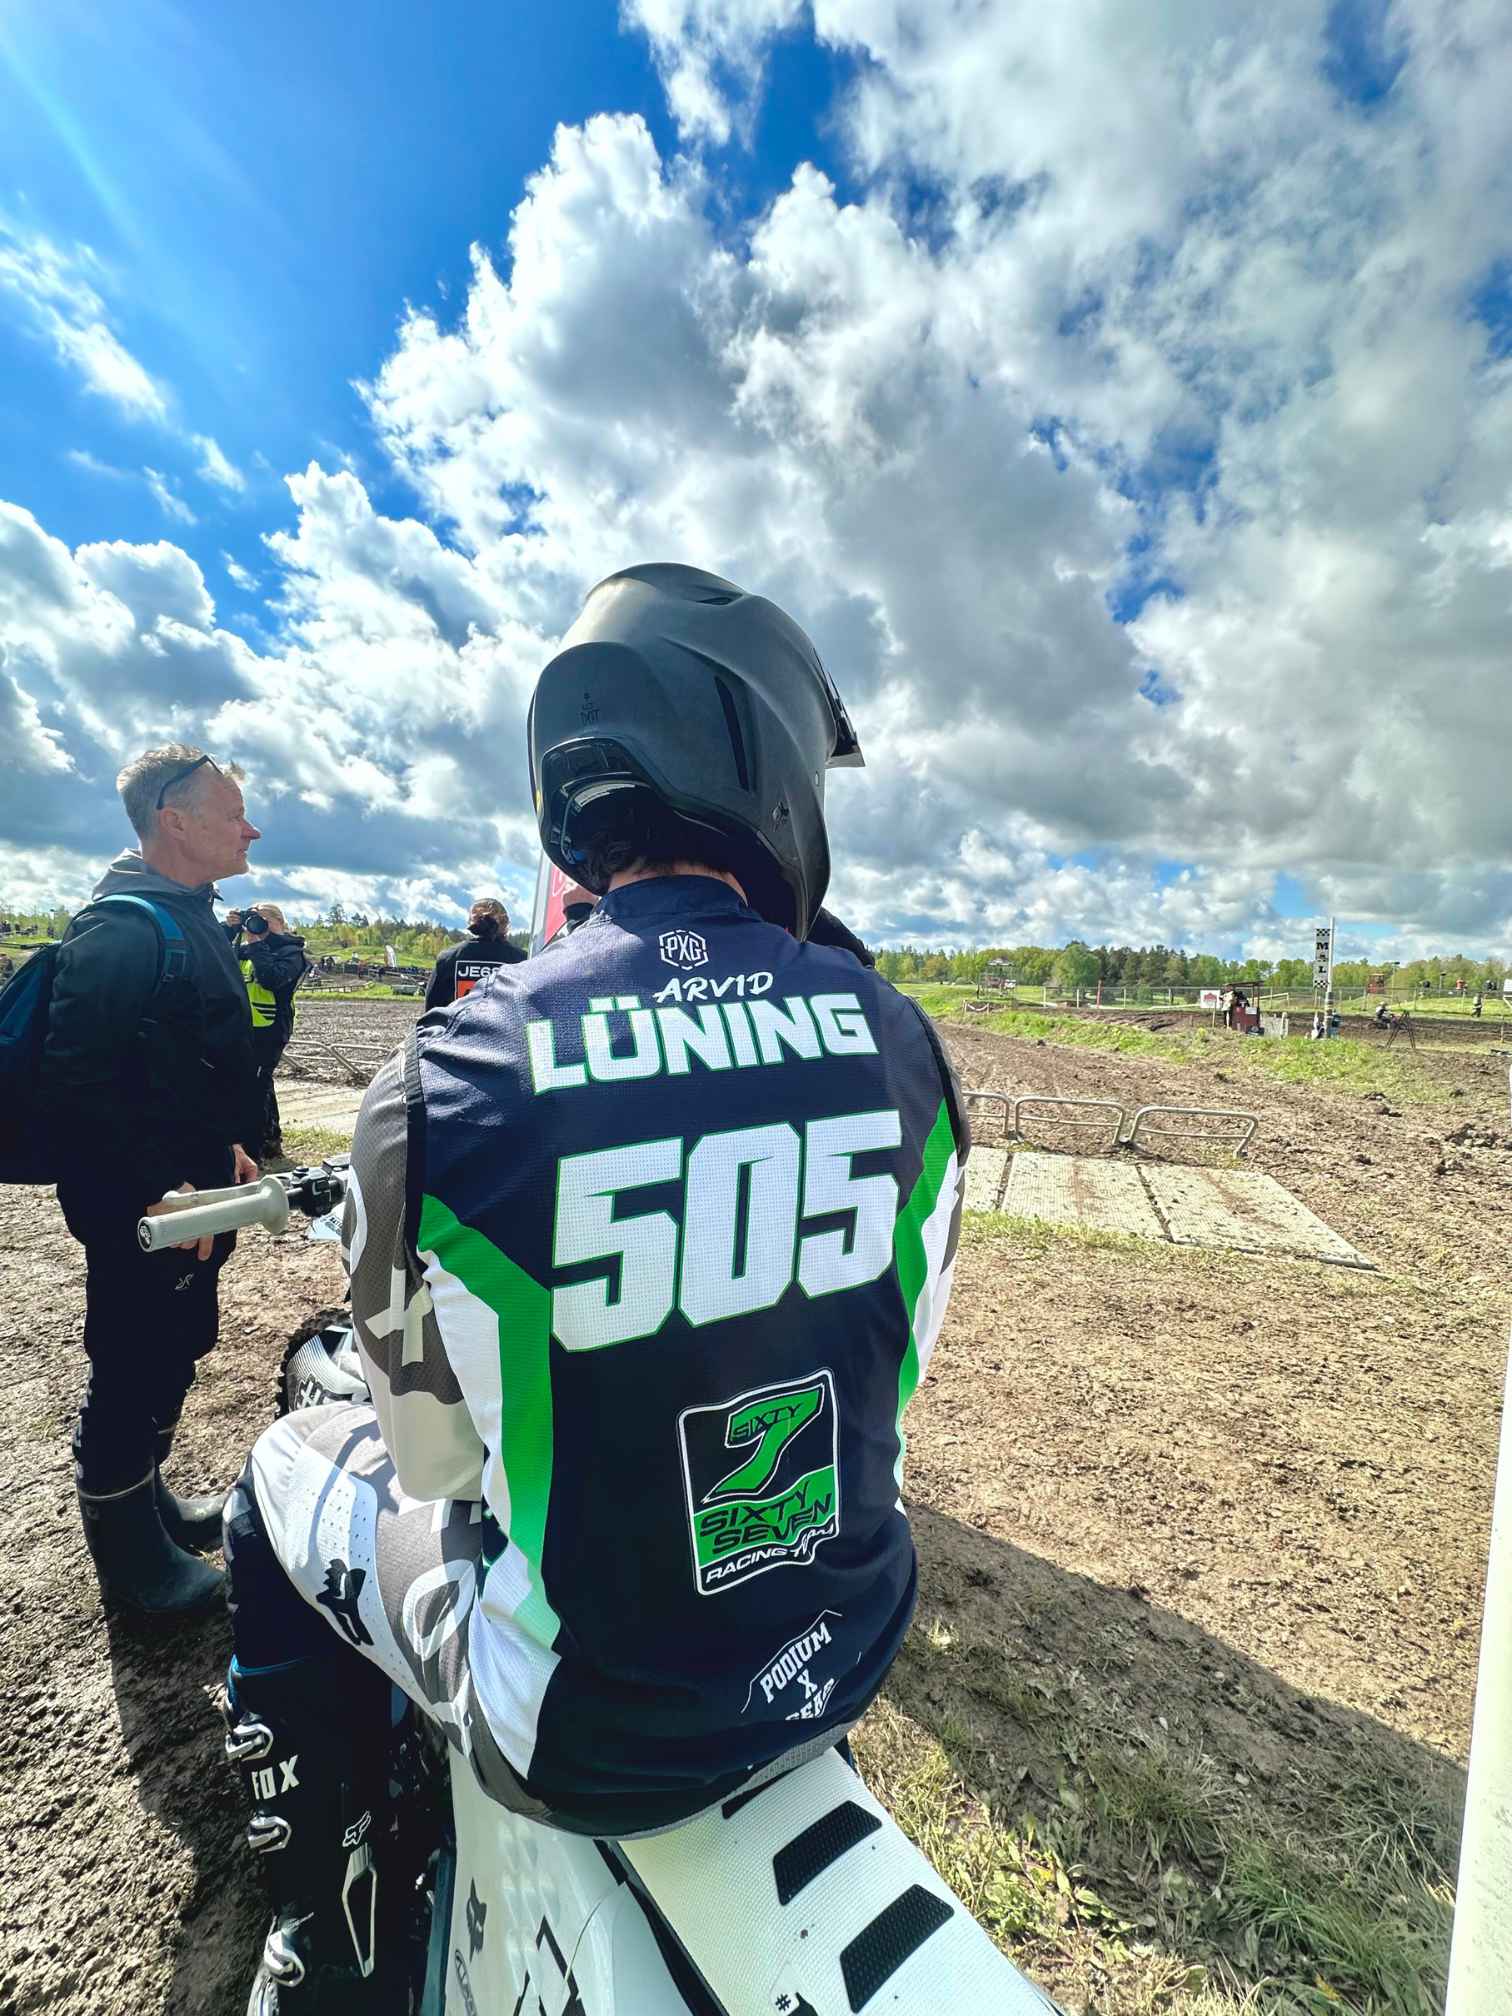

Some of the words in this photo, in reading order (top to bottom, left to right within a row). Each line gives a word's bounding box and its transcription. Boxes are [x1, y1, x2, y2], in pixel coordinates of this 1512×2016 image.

[665, 935, 702, 961] PXG
[652, 971, 774, 1003] ARVID
[527, 992, 880, 1095] LÜNING
[551, 1109, 903, 1353] 505
[731, 1402, 804, 1440] SIXTY
[700, 1480, 809, 1537] SIXTY
[713, 1492, 832, 1555] SEVEN
[706, 1547, 788, 1583] RACING
[760, 1621, 832, 1703] PODIUM
[797, 1669, 818, 1699] X
[251, 1754, 300, 1800] FOX
